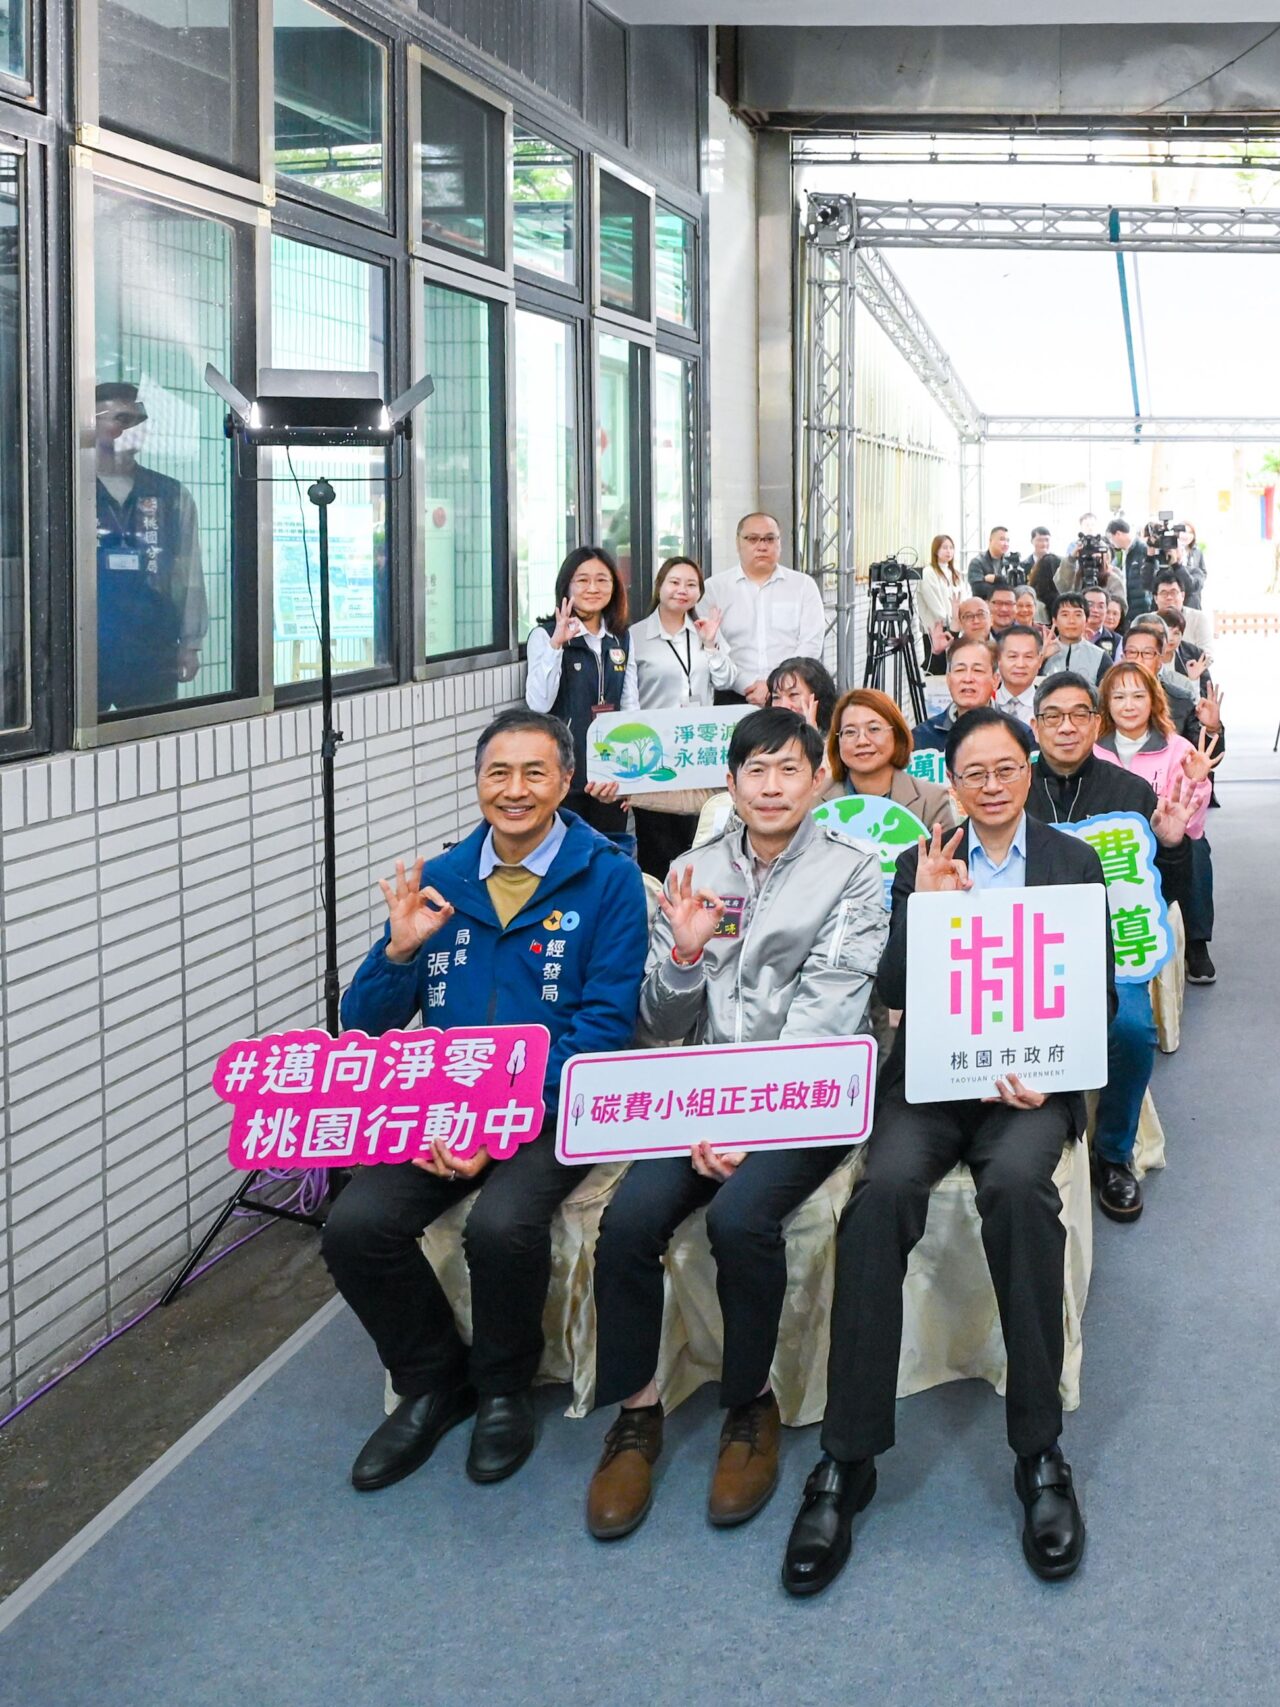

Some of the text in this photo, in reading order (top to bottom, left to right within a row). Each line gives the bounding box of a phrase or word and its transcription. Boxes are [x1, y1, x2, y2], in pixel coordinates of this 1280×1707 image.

[453, 928, 471, 967] 局長
[540, 938, 567, 1002] 經發局
[427, 951, 451, 1008] 張誠
[224, 1036, 497, 1096] #邁向淨零
[951, 1044, 1065, 1071] 桃園市政府
[951, 1075, 988, 1084] TAOYUAN
[1017, 1069, 1065, 1079] OVERNMENT
[590, 1080, 841, 1124] 碳費小組正式啟動
[242, 1100, 535, 1160] 桃園行動中
